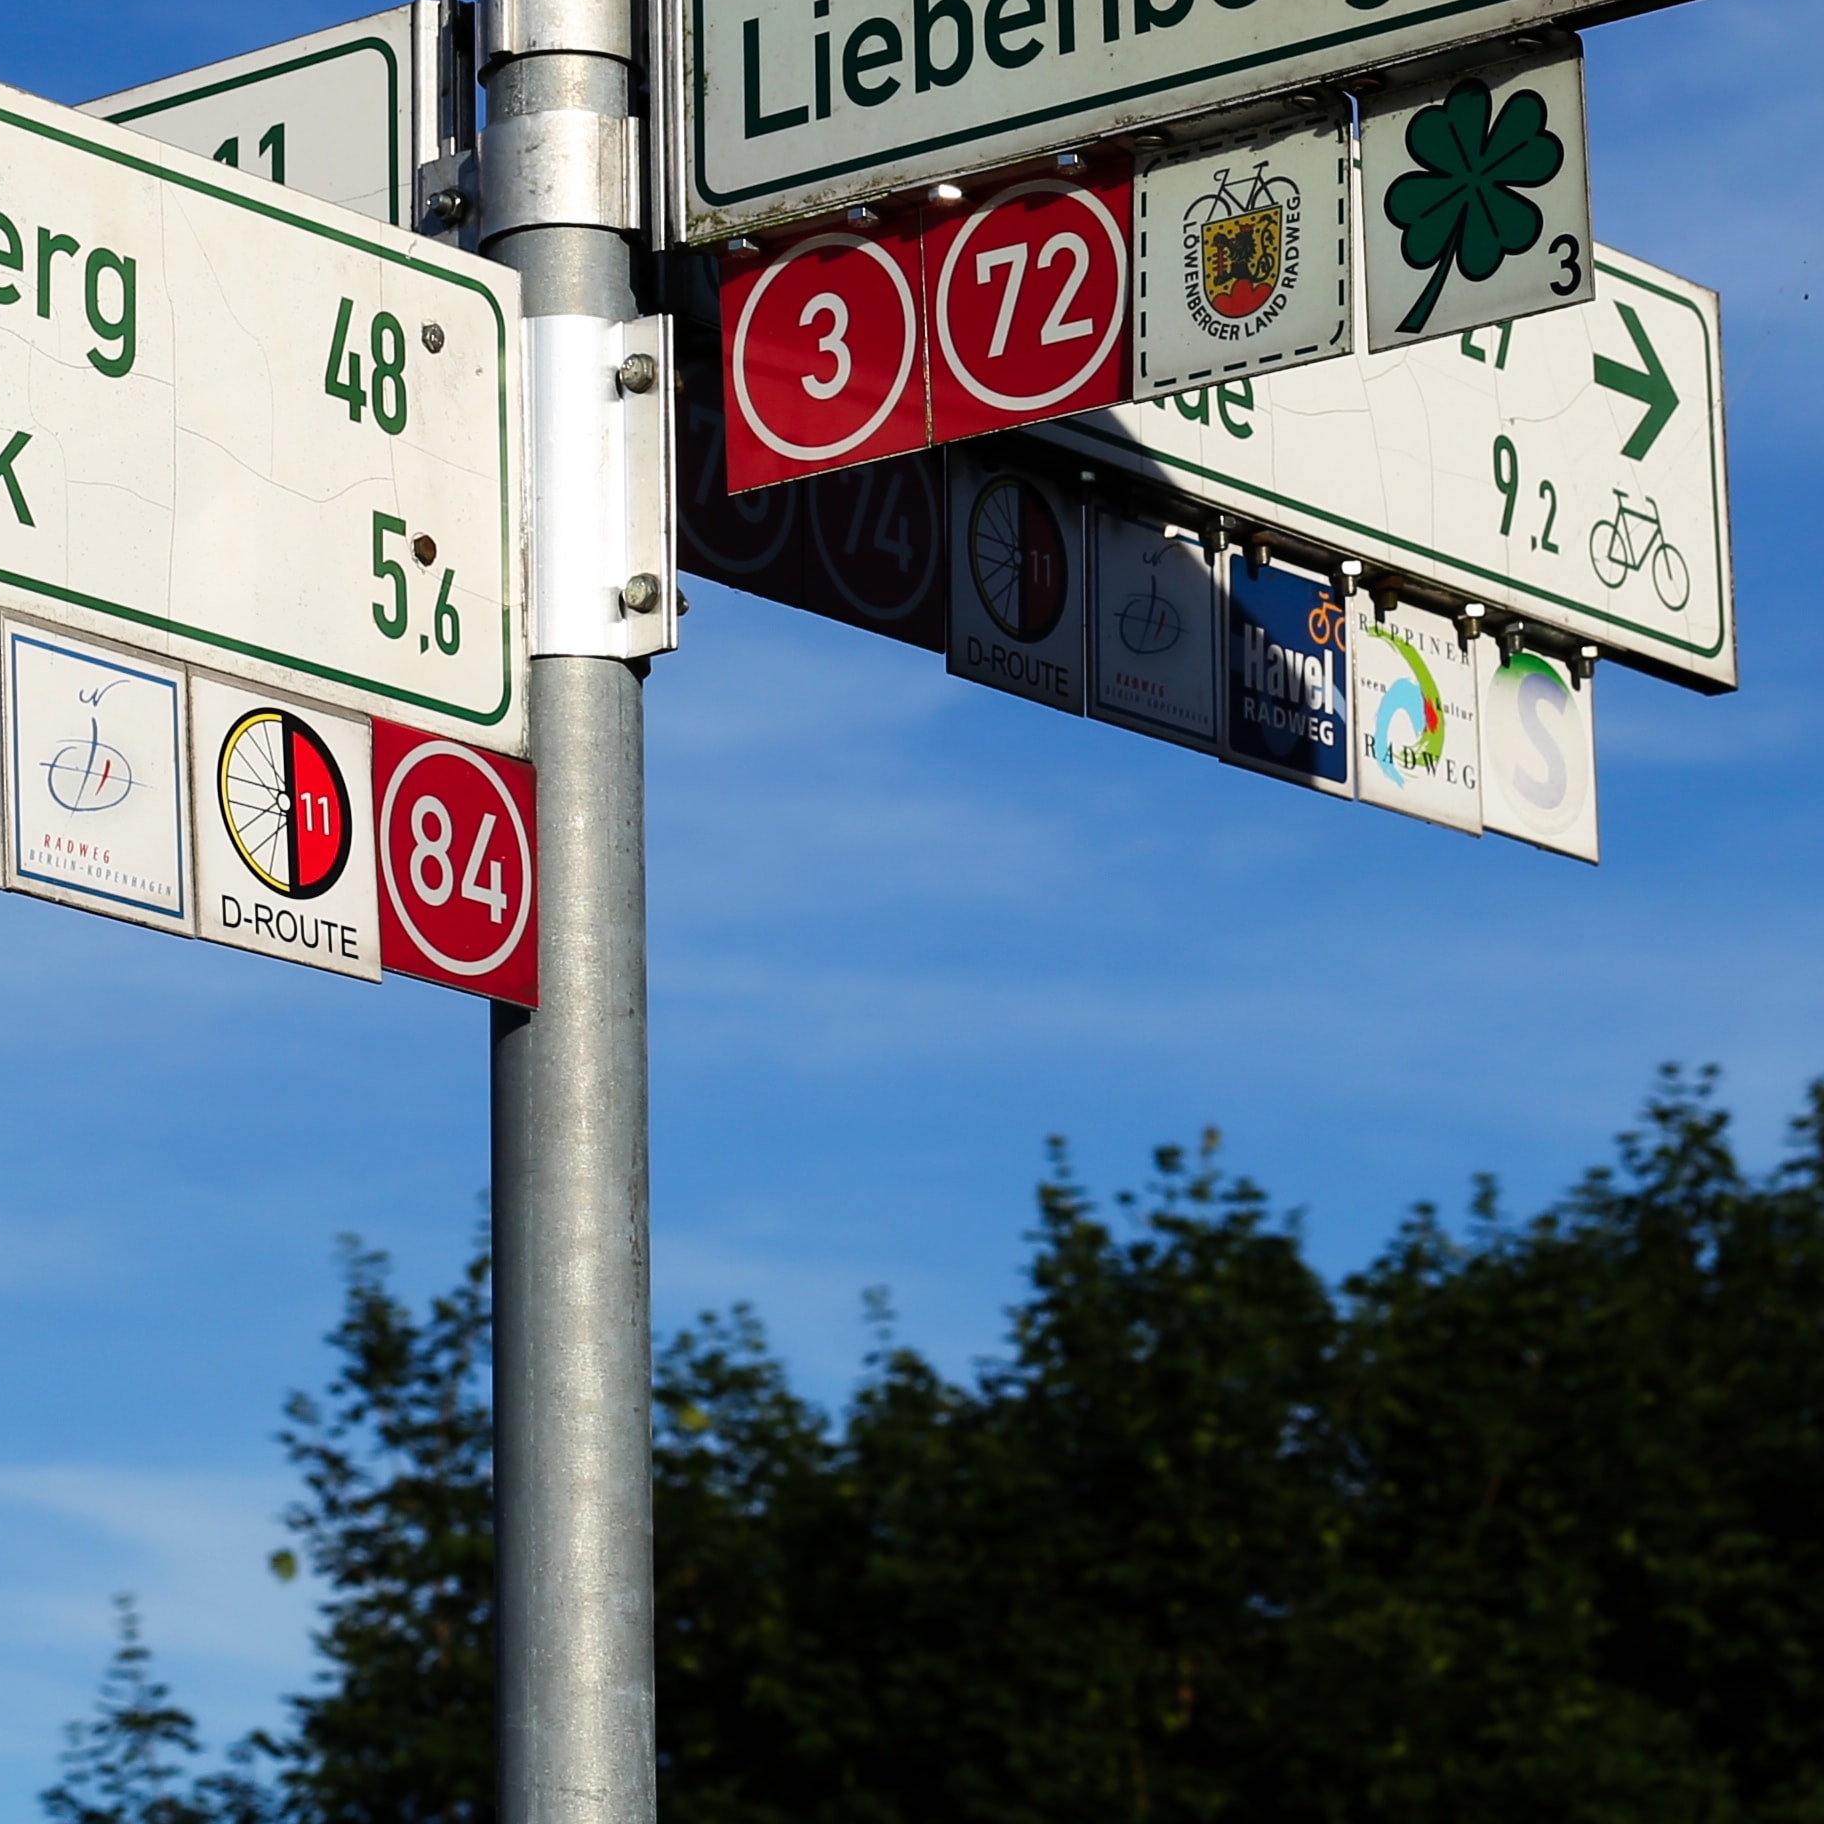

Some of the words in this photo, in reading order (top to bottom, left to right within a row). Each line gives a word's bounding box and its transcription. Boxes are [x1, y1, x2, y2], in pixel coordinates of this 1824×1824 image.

[975, 231, 1094, 360] 72
[1183, 220, 1240, 341] LÖWENBERGER
[1244, 293, 1288, 338] LAND
[1280, 194, 1301, 290] RADWEG
[1547, 233, 1583, 296] 3
[324, 297, 408, 437] 48
[797, 291, 853, 401] 3
[966, 636, 1070, 698] D-ROUTE
[1243, 623, 1335, 716] Havel
[1359, 612, 1472, 667] RUPPINER
[1243, 695, 1336, 747] RADWEG
[1360, 677, 1388, 694] seen
[1435, 697, 1475, 723] kultur
[1363, 733, 1477, 791] RADWEG
[1511, 672, 1569, 811] S
[299, 791, 330, 837] 11
[29, 848, 172, 897] BERLIN-KOPENHAGEN
[43, 833, 111, 865] RADWEG
[409, 794, 508, 925] 84
[221, 893, 360, 960] D-ROUTE
